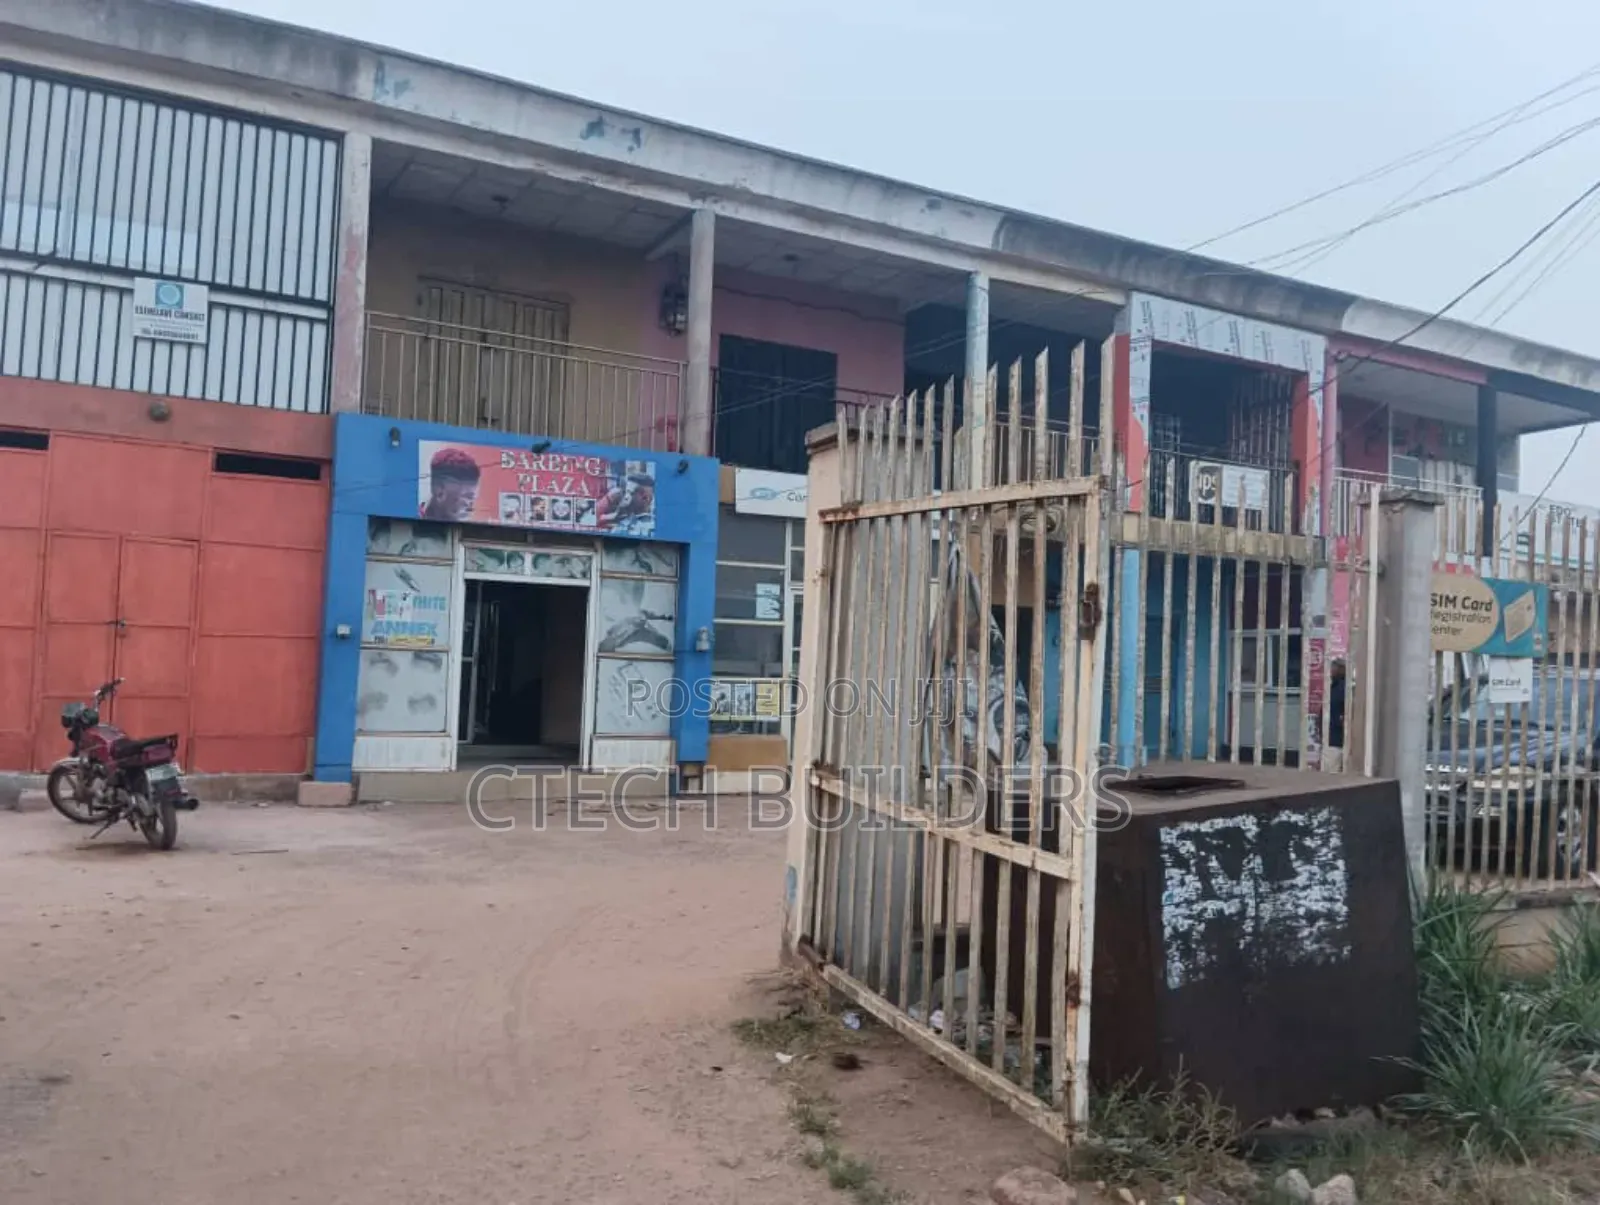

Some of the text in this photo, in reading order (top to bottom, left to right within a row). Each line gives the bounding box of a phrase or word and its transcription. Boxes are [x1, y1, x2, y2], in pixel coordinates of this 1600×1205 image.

[517, 473, 591, 497] PLAZA
[1430, 593, 1493, 612] SIM Card
[1431, 625, 1463, 636] enter
